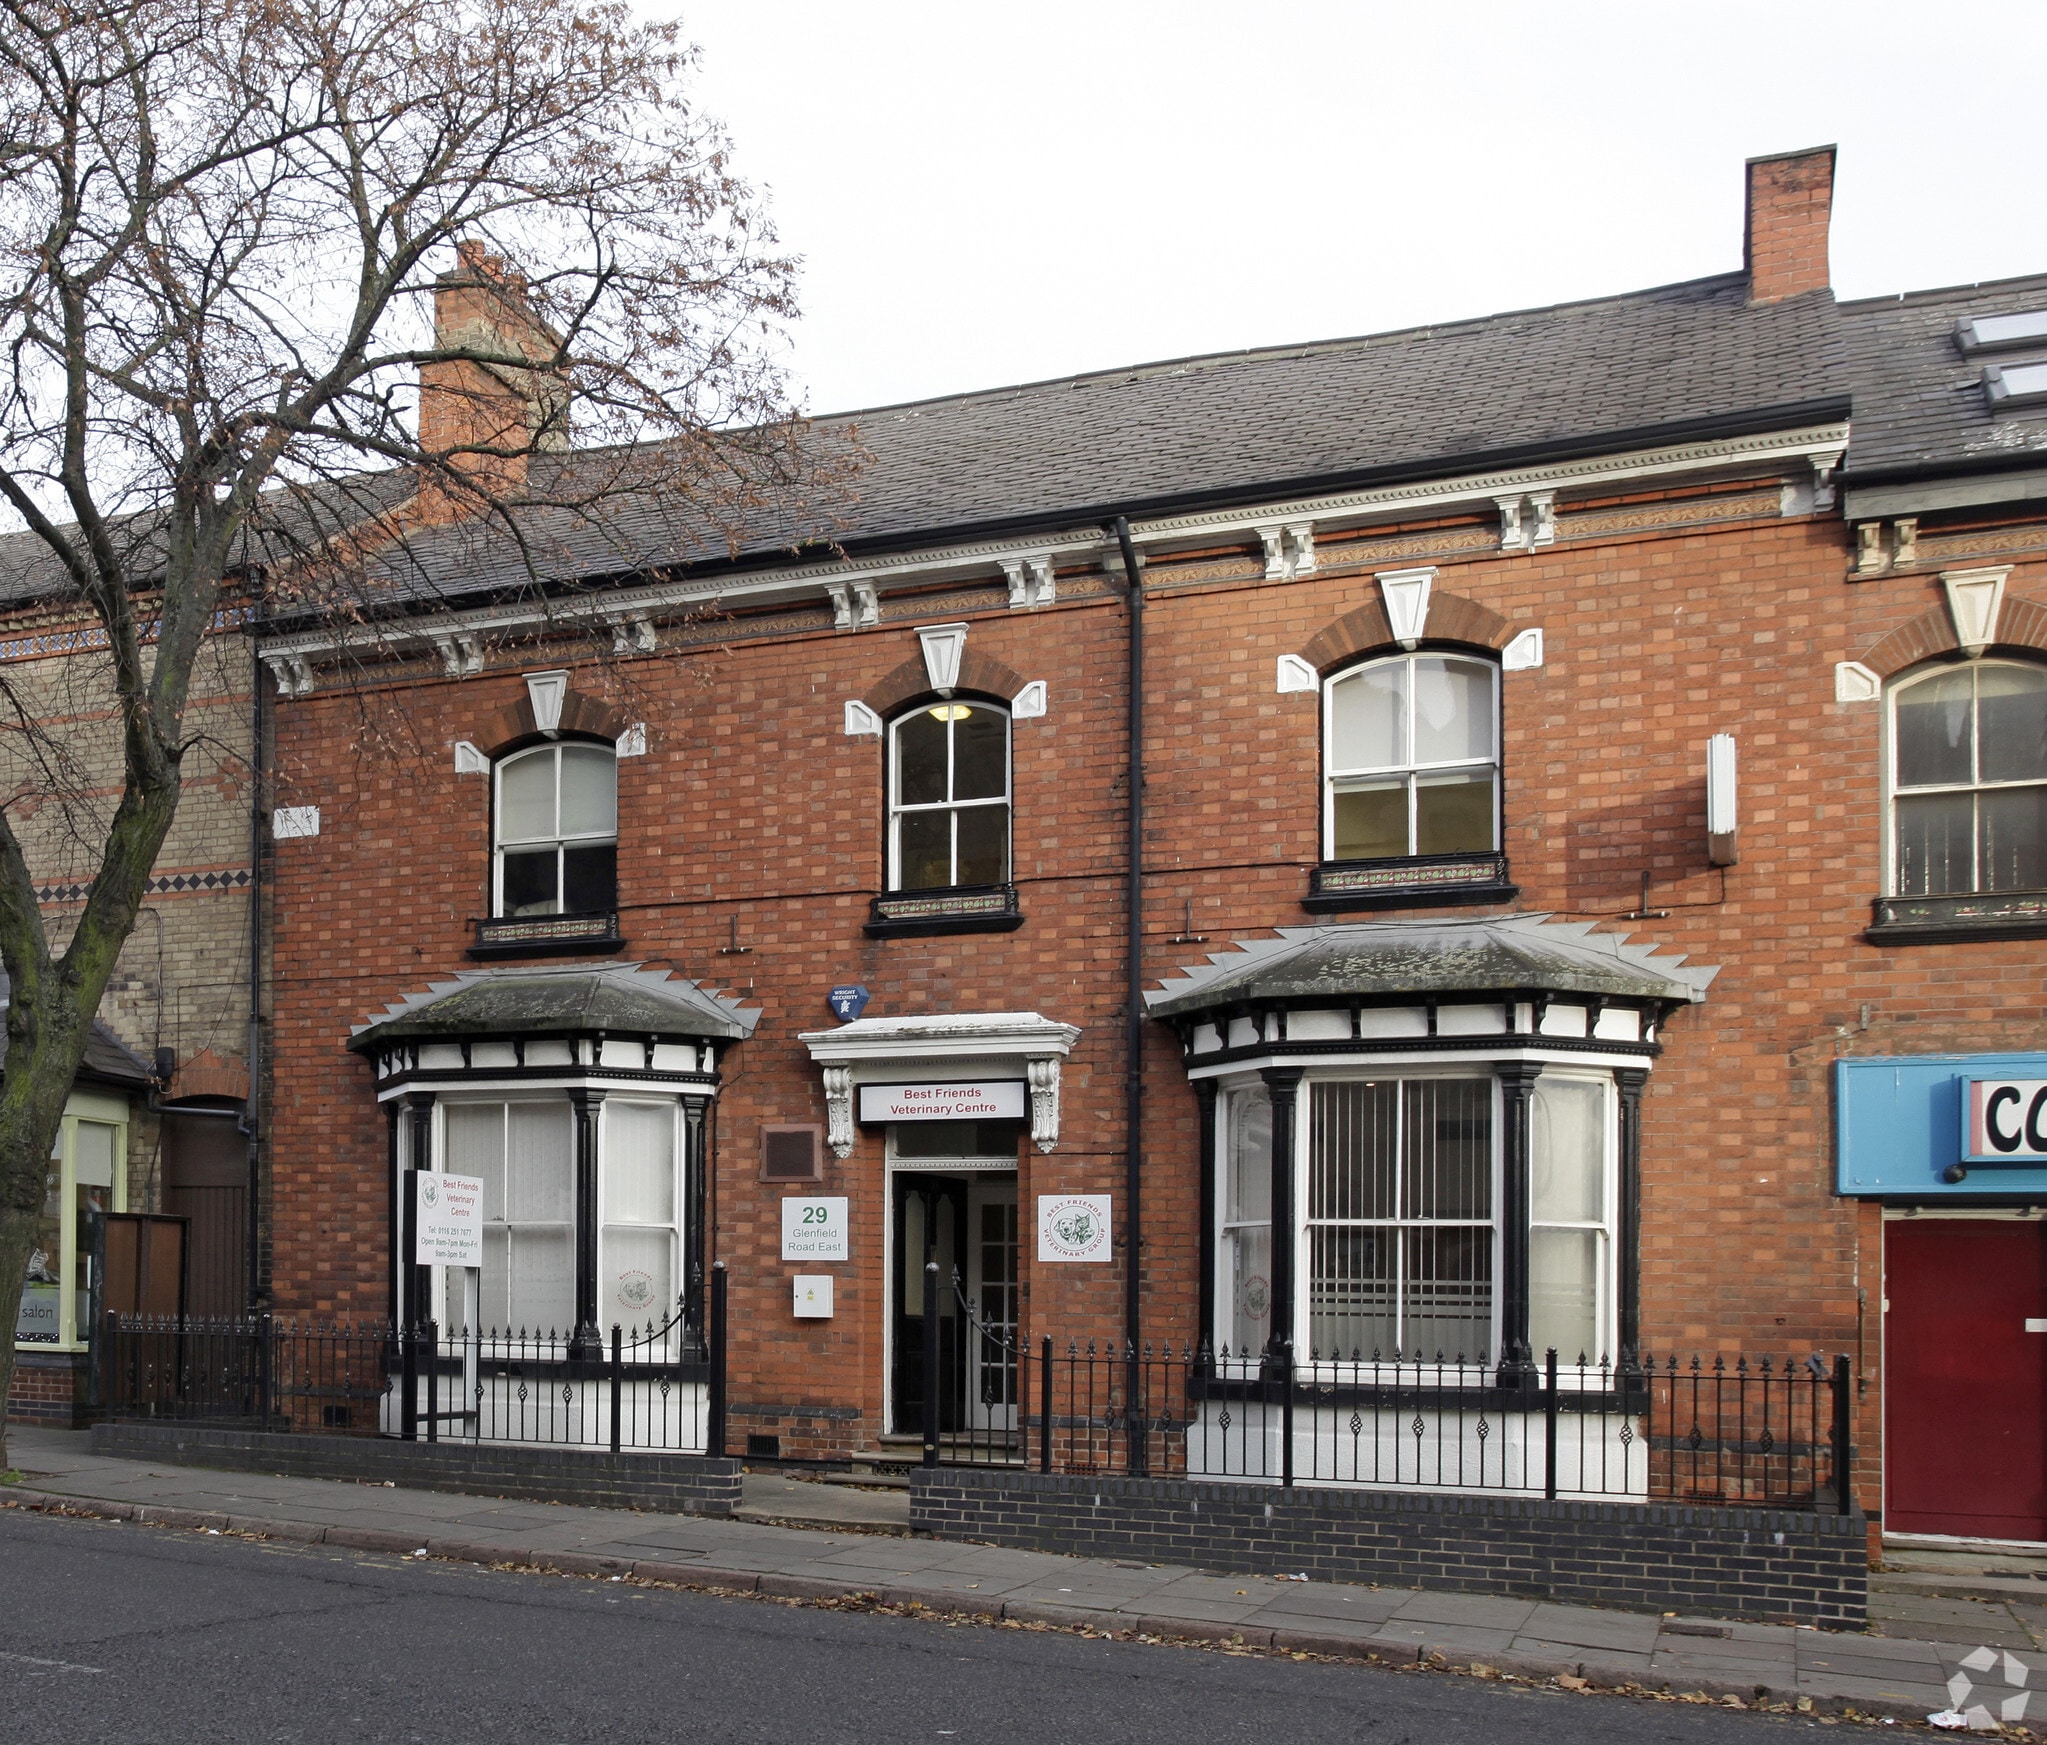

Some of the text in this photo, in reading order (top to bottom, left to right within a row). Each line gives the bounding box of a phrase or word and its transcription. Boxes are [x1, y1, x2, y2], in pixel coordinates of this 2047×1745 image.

[904, 1088, 982, 1099] Best Friends
[890, 1103, 997, 1116] Veterinary Centre
[443, 1180, 456, 1189] Best
[458, 1181, 478, 1191] Friends
[446, 1194, 475, 1206] Veterinary
[451, 1207, 470, 1217] Centre
[1047, 1199, 1103, 1218] BEST FRIENDS
[802, 1206, 828, 1224] 29
[792, 1228, 838, 1238] Glenfield
[421, 1237, 435, 1246] Open
[459, 1239, 478, 1249] Mon-Fri
[788, 1242, 841, 1252] Road East
[1044, 1228, 1106, 1257] VETERINARY GROUP
[459, 1250, 467, 1258] Sat
[22, 1305, 53, 1319] salon
